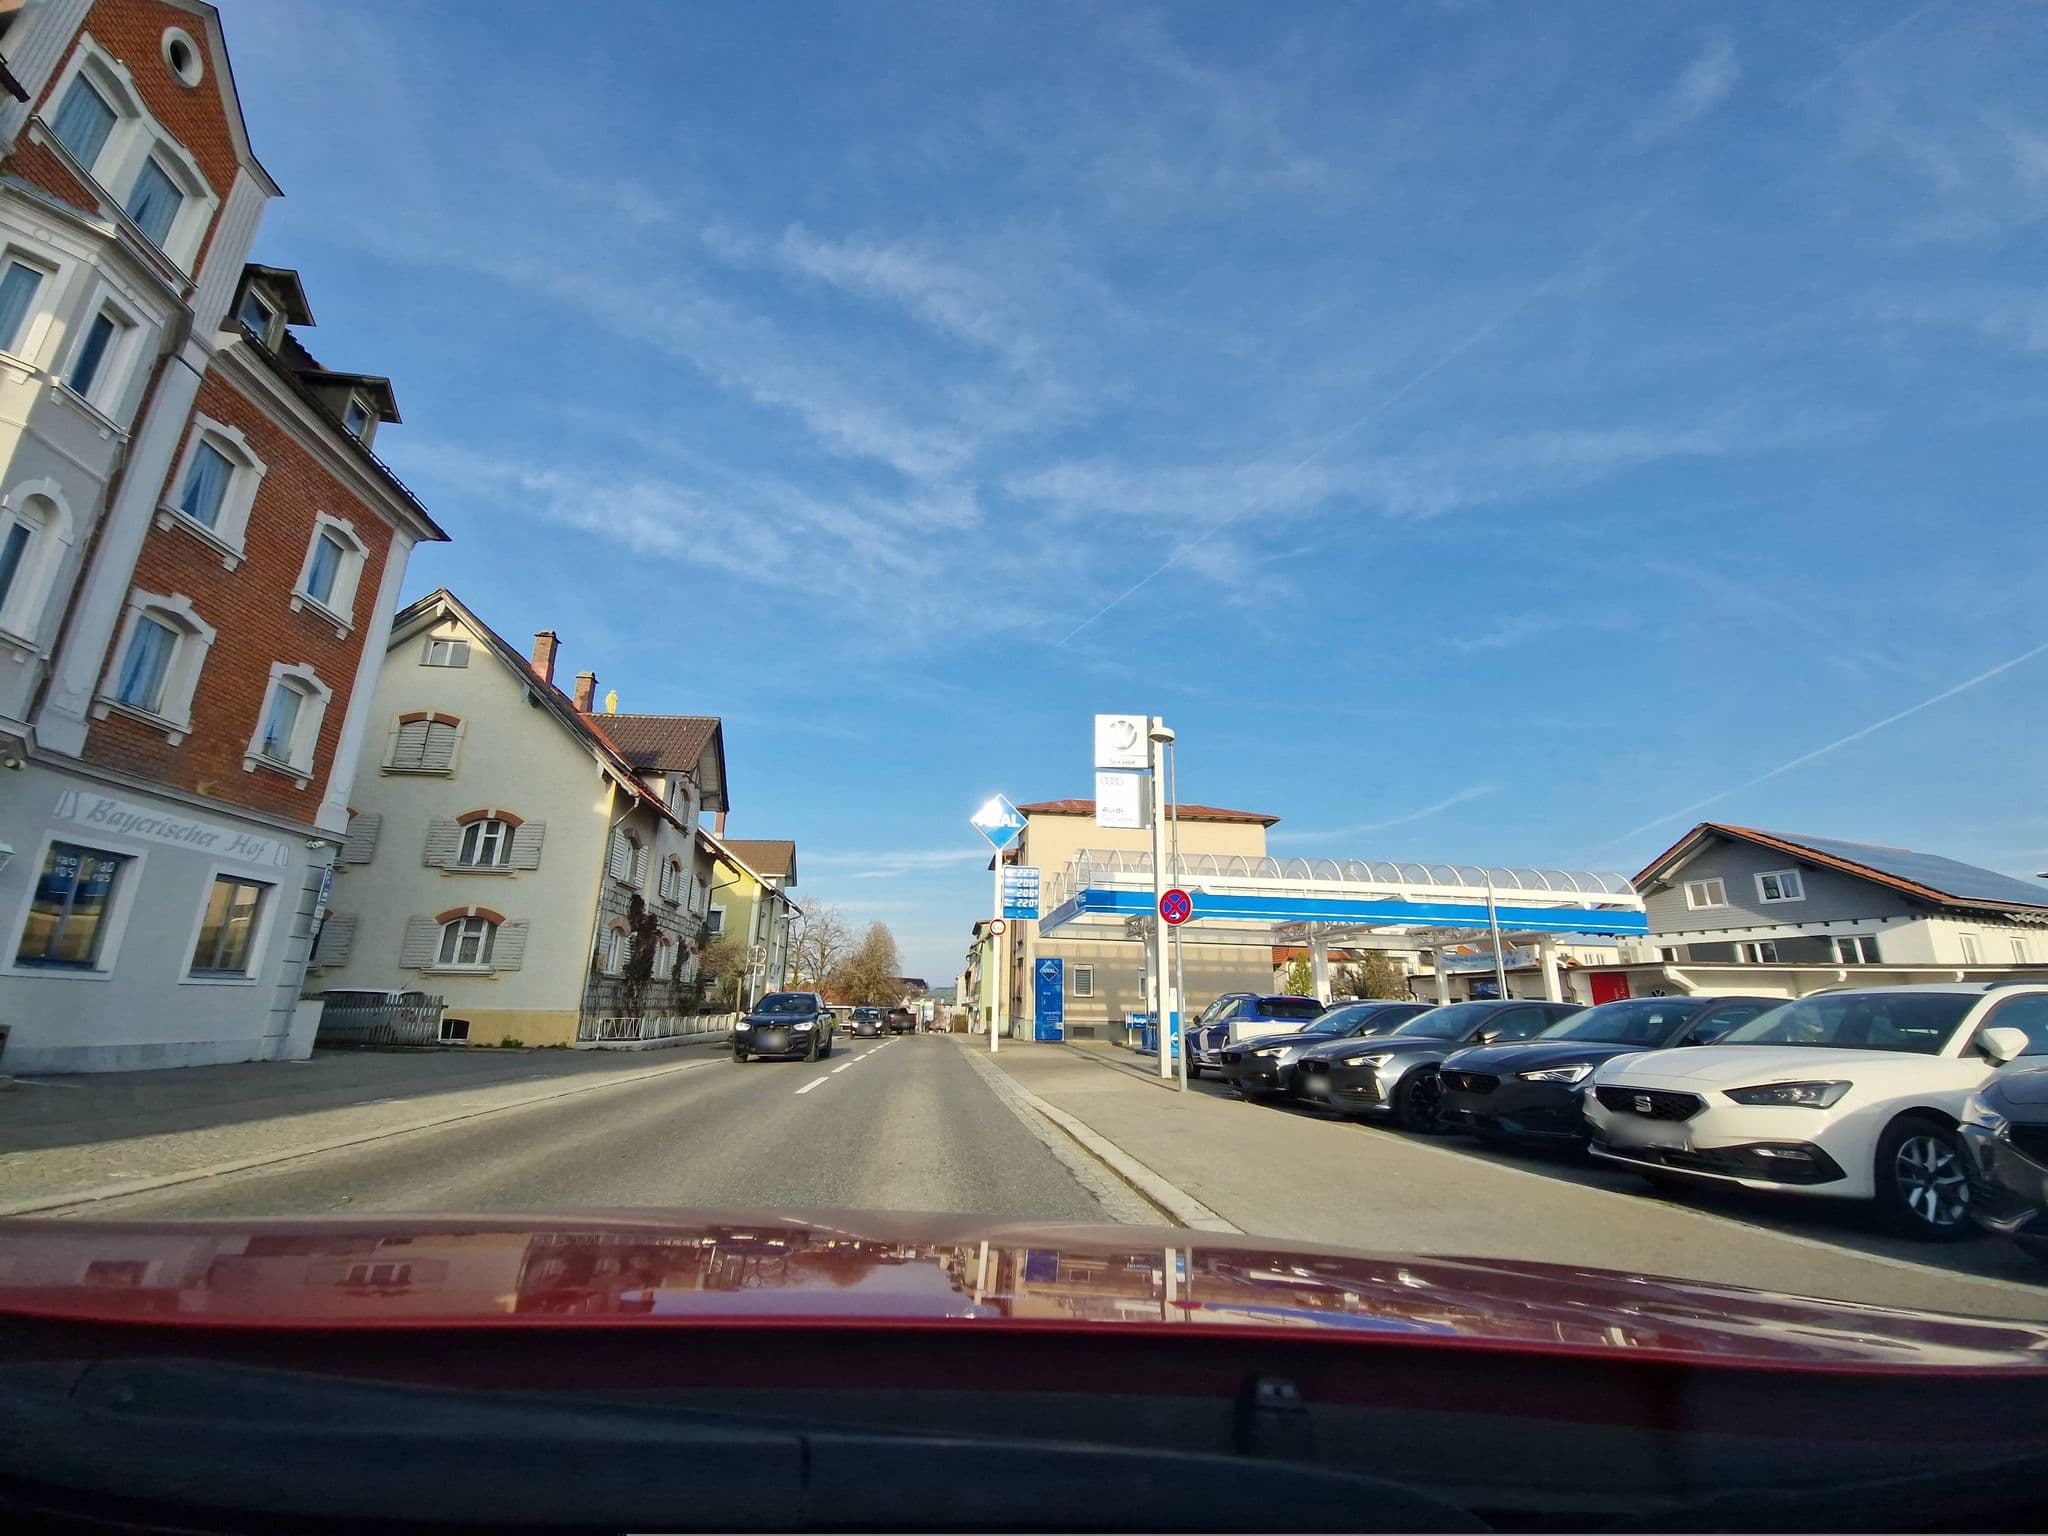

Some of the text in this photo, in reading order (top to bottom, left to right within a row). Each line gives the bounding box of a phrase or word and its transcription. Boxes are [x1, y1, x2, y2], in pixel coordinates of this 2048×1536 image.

[1102, 806, 1124, 814] Audi
[86, 800, 267, 862] Bayerischer Hof
